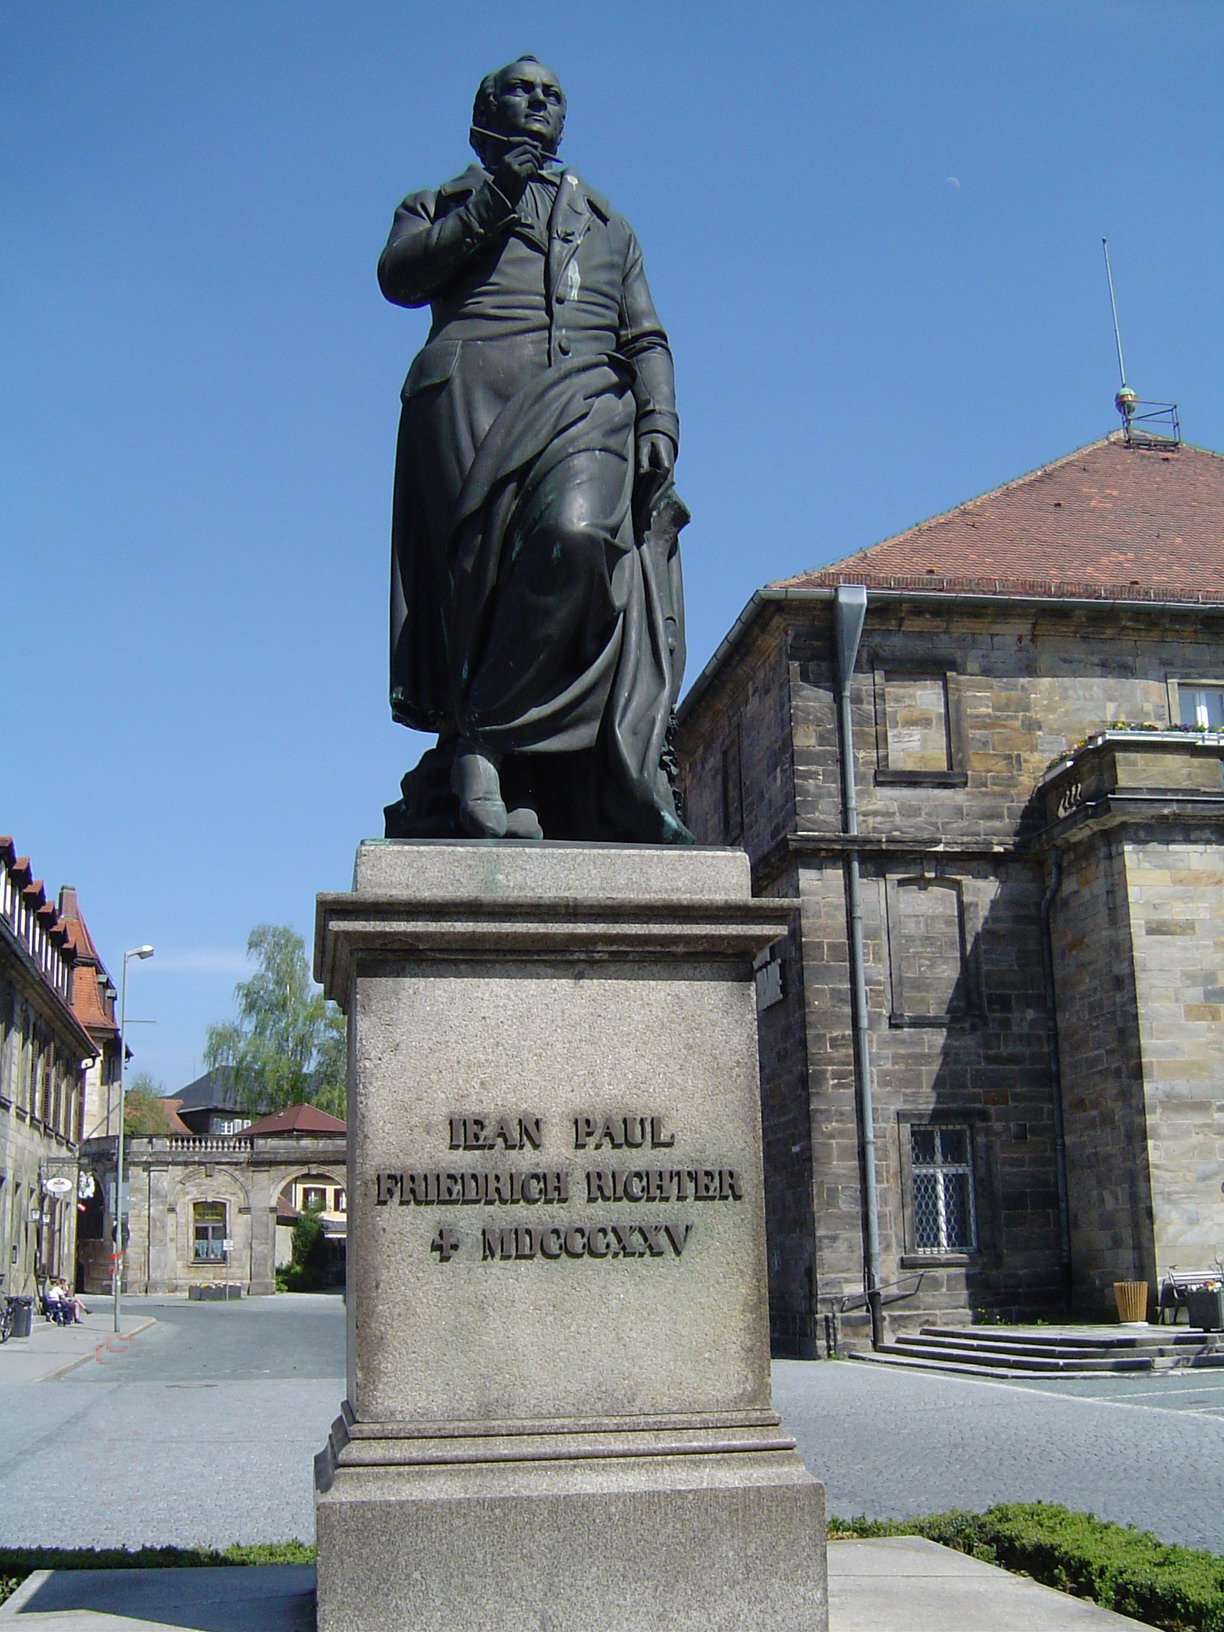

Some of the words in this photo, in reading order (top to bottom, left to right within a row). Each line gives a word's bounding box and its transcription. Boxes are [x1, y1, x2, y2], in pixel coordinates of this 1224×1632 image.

[574, 1115, 675, 1150] PAUL
[375, 1171, 569, 1206] FRIEDRICH
[587, 1168, 743, 1202] RICHTER
[482, 1224, 693, 1262] MDCCCXXV
